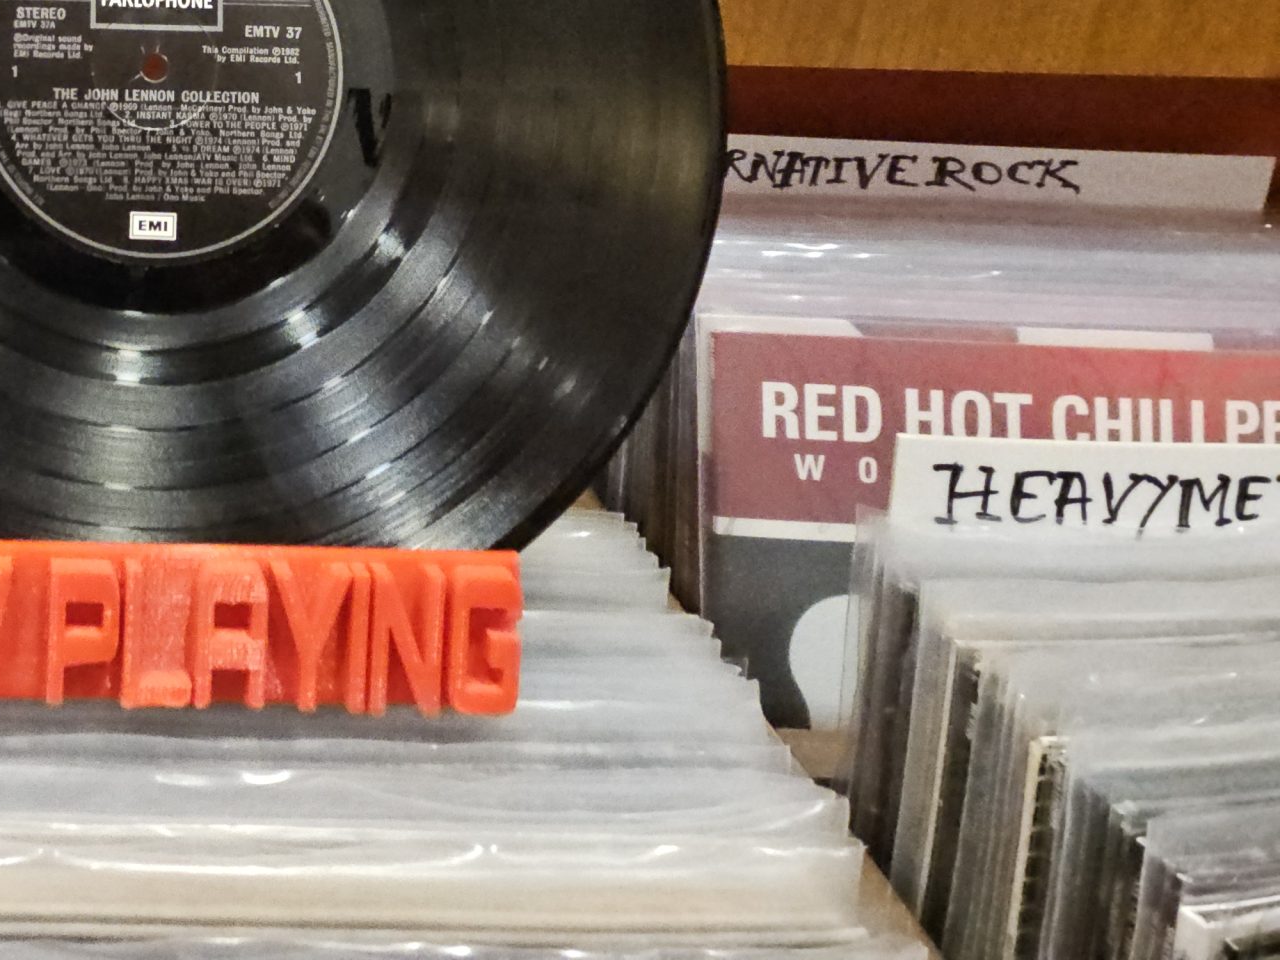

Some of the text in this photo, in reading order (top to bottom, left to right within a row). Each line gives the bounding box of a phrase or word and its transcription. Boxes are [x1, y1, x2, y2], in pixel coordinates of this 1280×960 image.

[16, 6, 67, 20] STEREO
[13, 20, 37, 29] EMTV
[244, 25, 302, 39] EMTV 37
[83, 43, 94, 52] by
[202, 45, 219, 54] This
[221, 45, 269, 55] Compilation
[217, 54, 227, 63] by
[230, 54, 246, 63] EMI
[11, 65, 18, 78] 1
[294, 71, 302, 84] 1
[52, 87, 260, 104] THE JOHN LENNON COLLECTION
[925, 156, 1081, 194] ROCK
[138, 220, 168, 232] EMI
[761, 381, 883, 443] RED
[904, 387, 1033, 440] HOT
[933, 462, 1280, 539] HEAVYME
[45, 556, 523, 717] PLAYING
